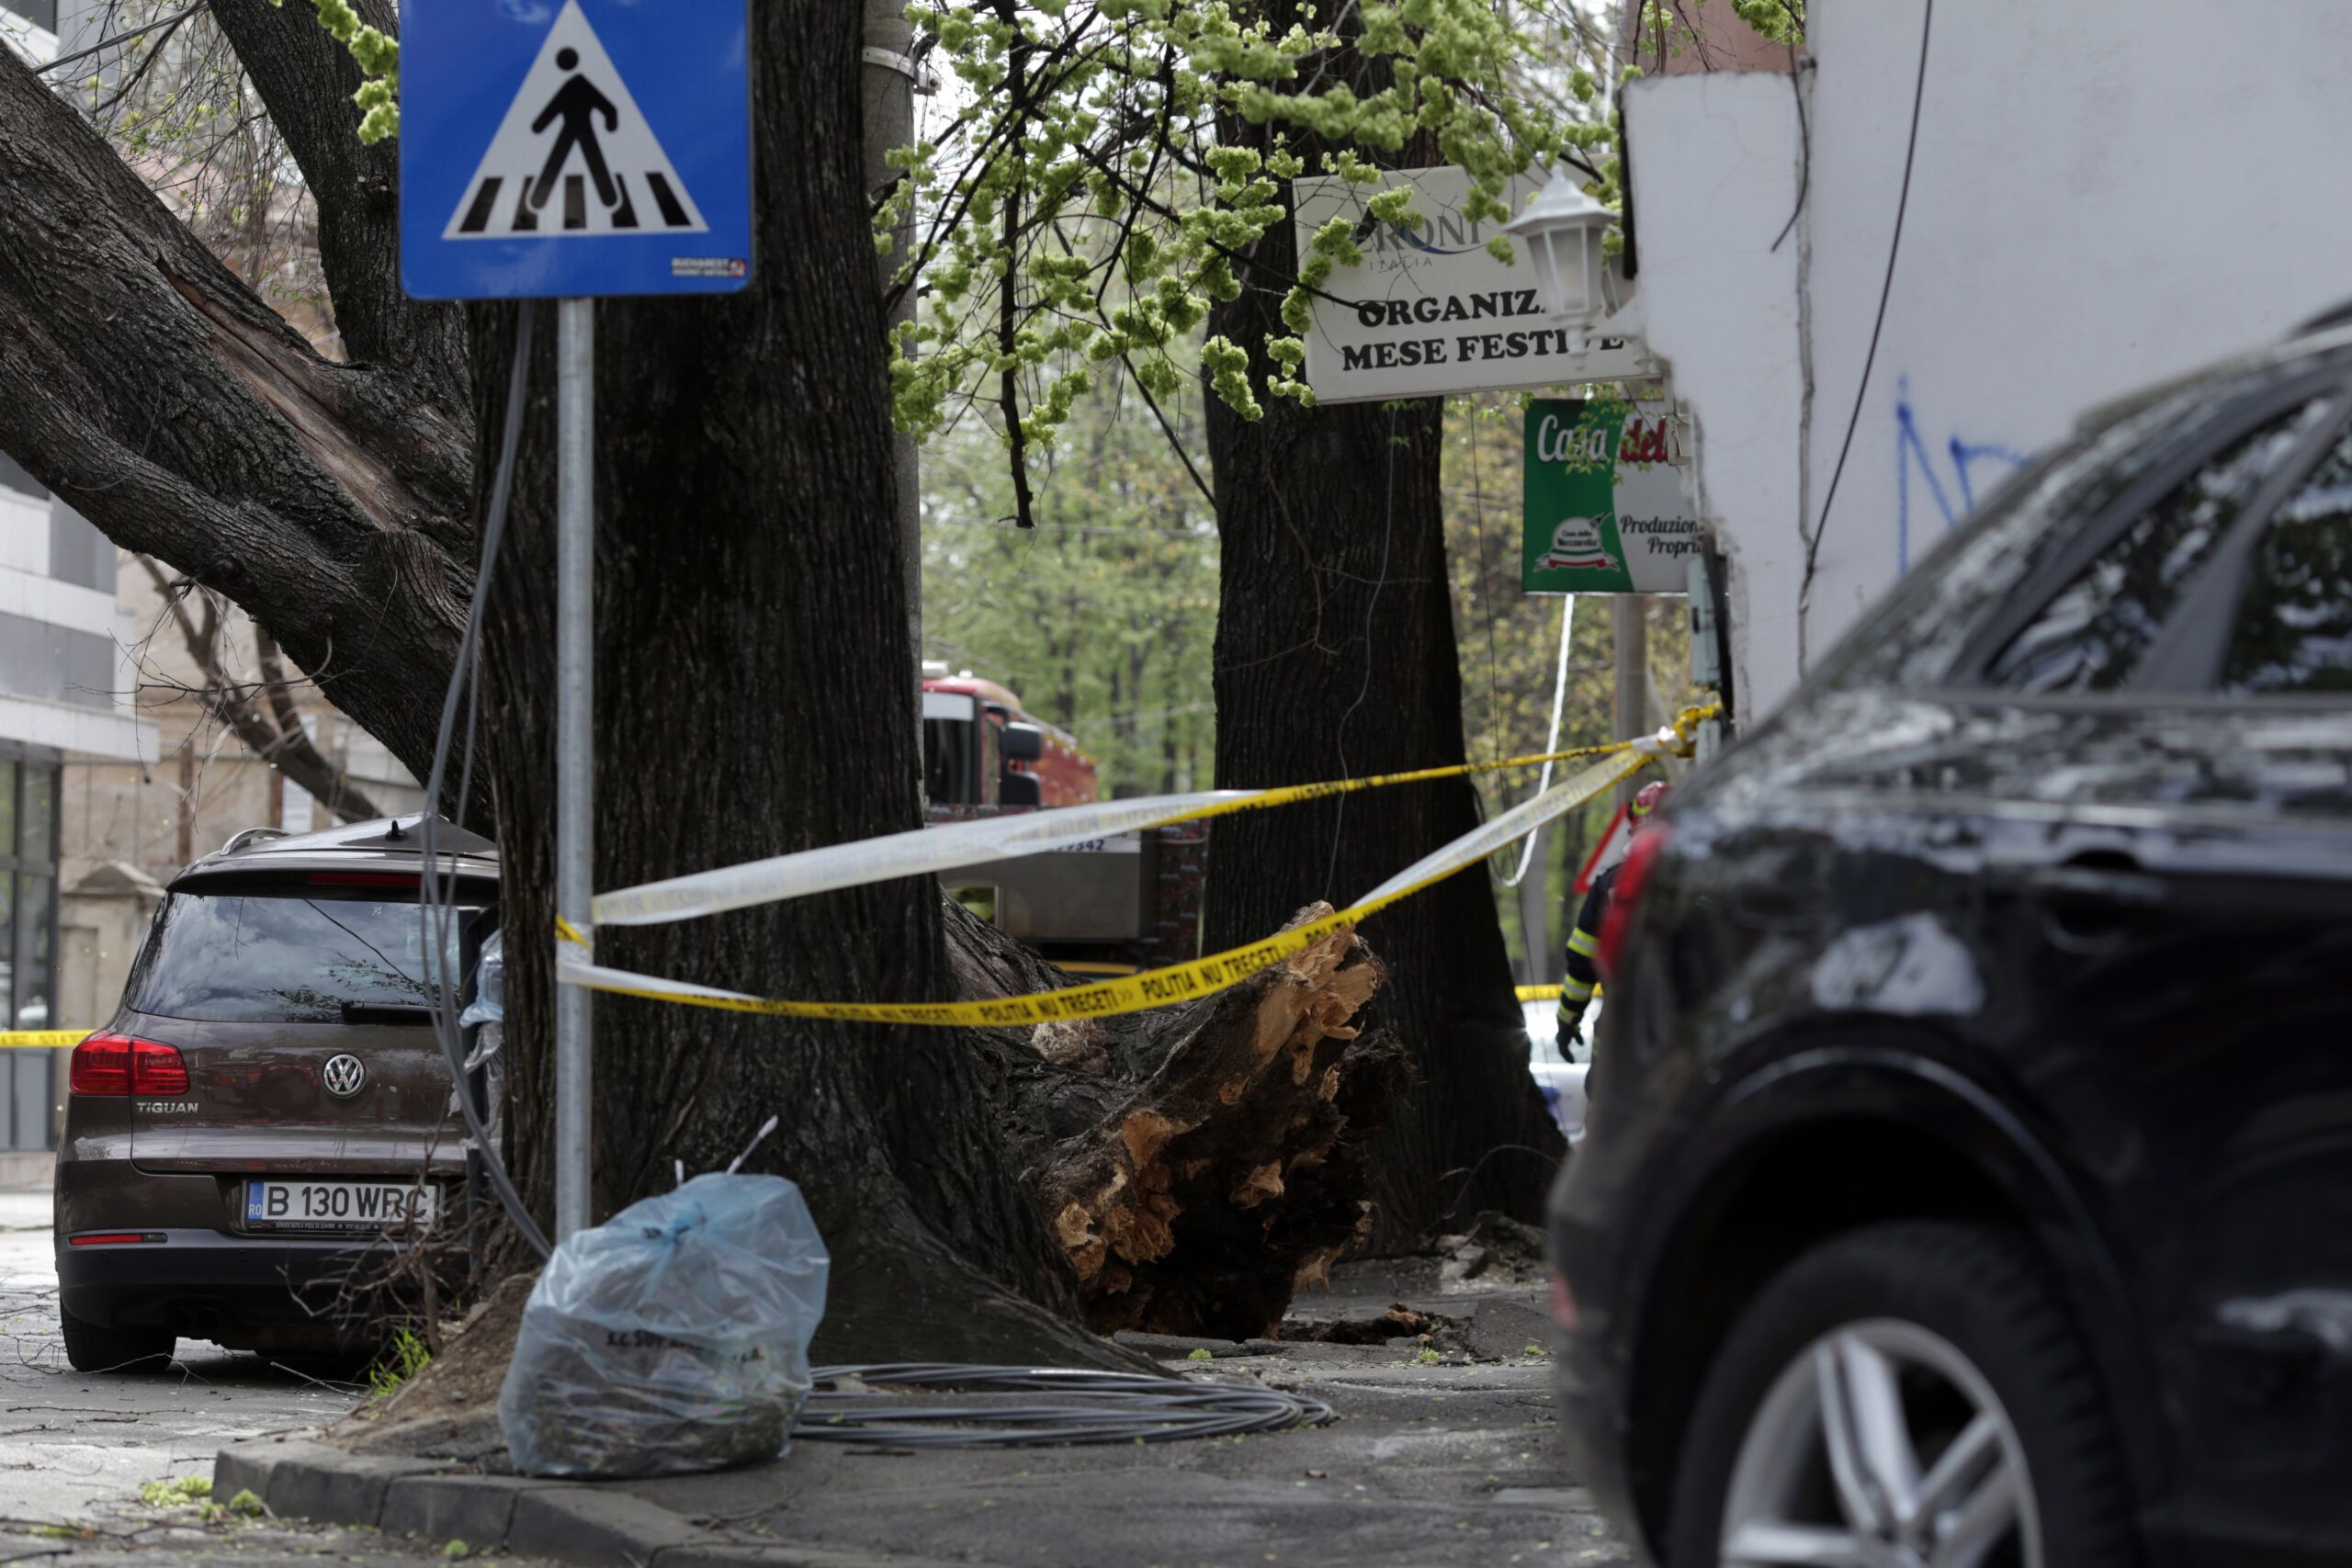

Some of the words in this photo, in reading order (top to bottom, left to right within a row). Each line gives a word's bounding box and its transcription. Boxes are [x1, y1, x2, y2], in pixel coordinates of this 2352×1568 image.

[1369, 256, 1433, 272] ITALIA
[1358, 288, 1546, 328] ORGANIZ
[1341, 337, 1447, 371] MESE
[1456, 328, 1624, 362] FESTIE
[1200, 969, 1223, 987] NU
[1036, 998, 1059, 1017] NU
[248, 1203, 262, 1216] RO
[267, 1186, 289, 1216] B
[301, 1186, 349, 1217] 130
[356, 1187, 427, 1218] WRC
